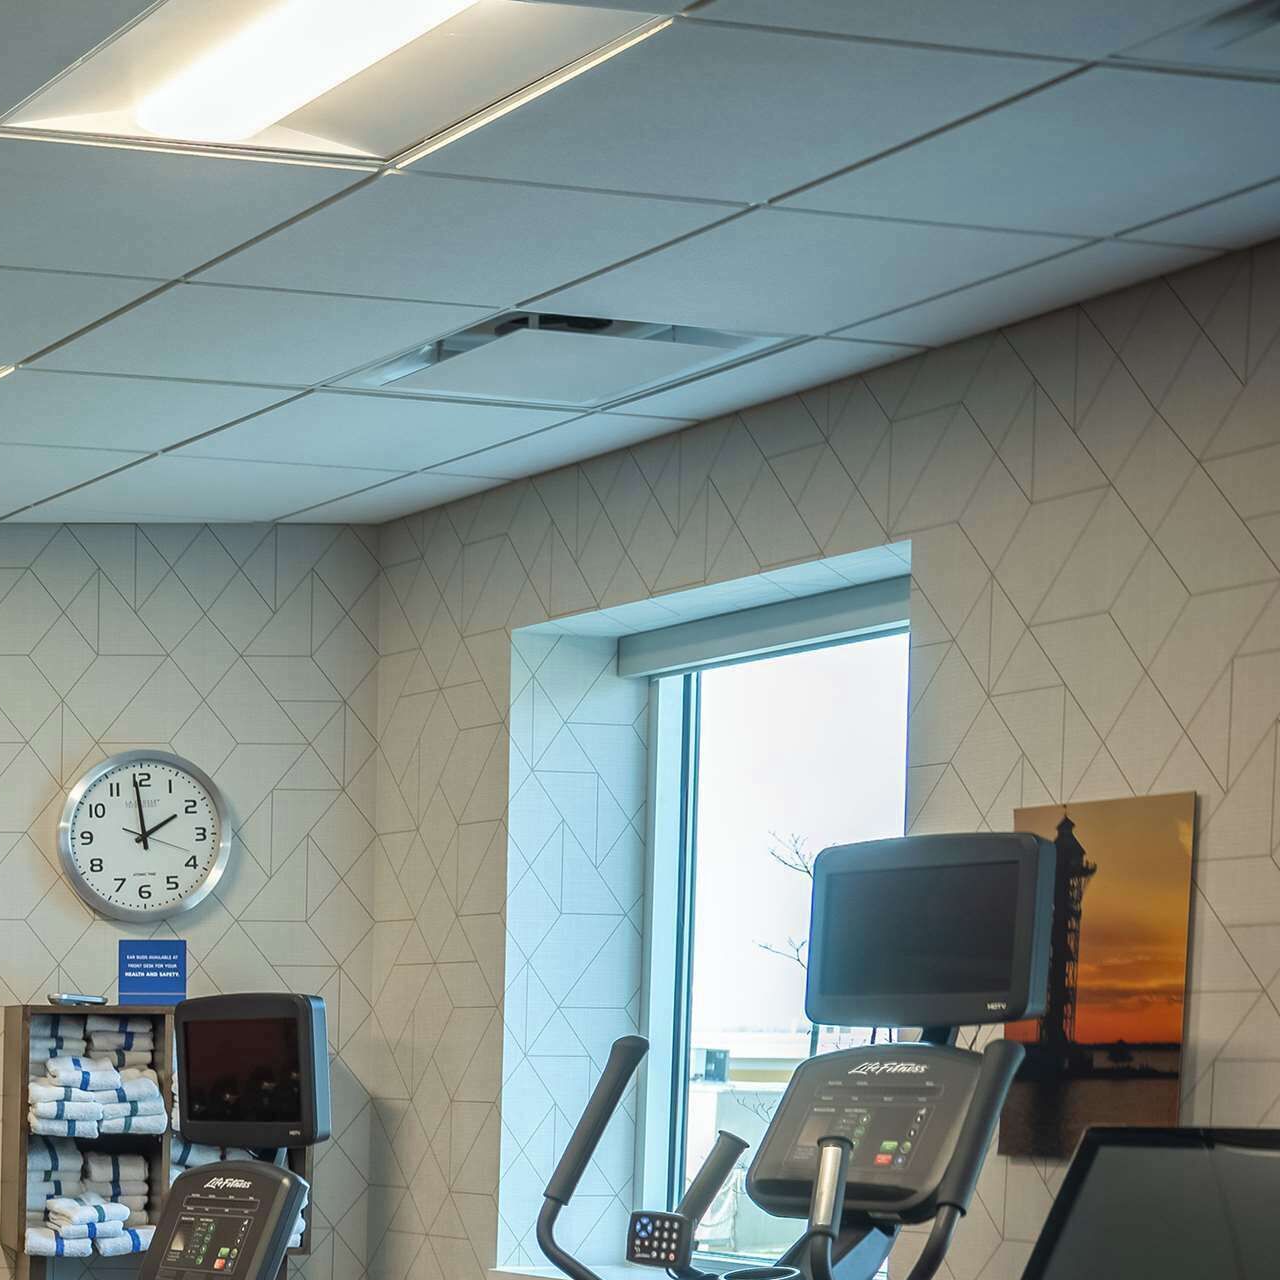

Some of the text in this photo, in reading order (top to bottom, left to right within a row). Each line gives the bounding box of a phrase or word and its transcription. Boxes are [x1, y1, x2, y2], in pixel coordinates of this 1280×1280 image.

[110, 783, 119, 797] 11
[89, 803, 106, 818] 10
[185, 800, 197, 814] 2
[81, 832, 93, 845] 9
[195, 827, 207, 841] 3
[90, 859, 103, 872] 8
[185, 855, 198, 870] 4
[114, 878, 126, 892] 7
[167, 876, 179, 890] 5
[138, 884, 152, 899] 6
[848, 1062, 928, 1075] Life Fitness
